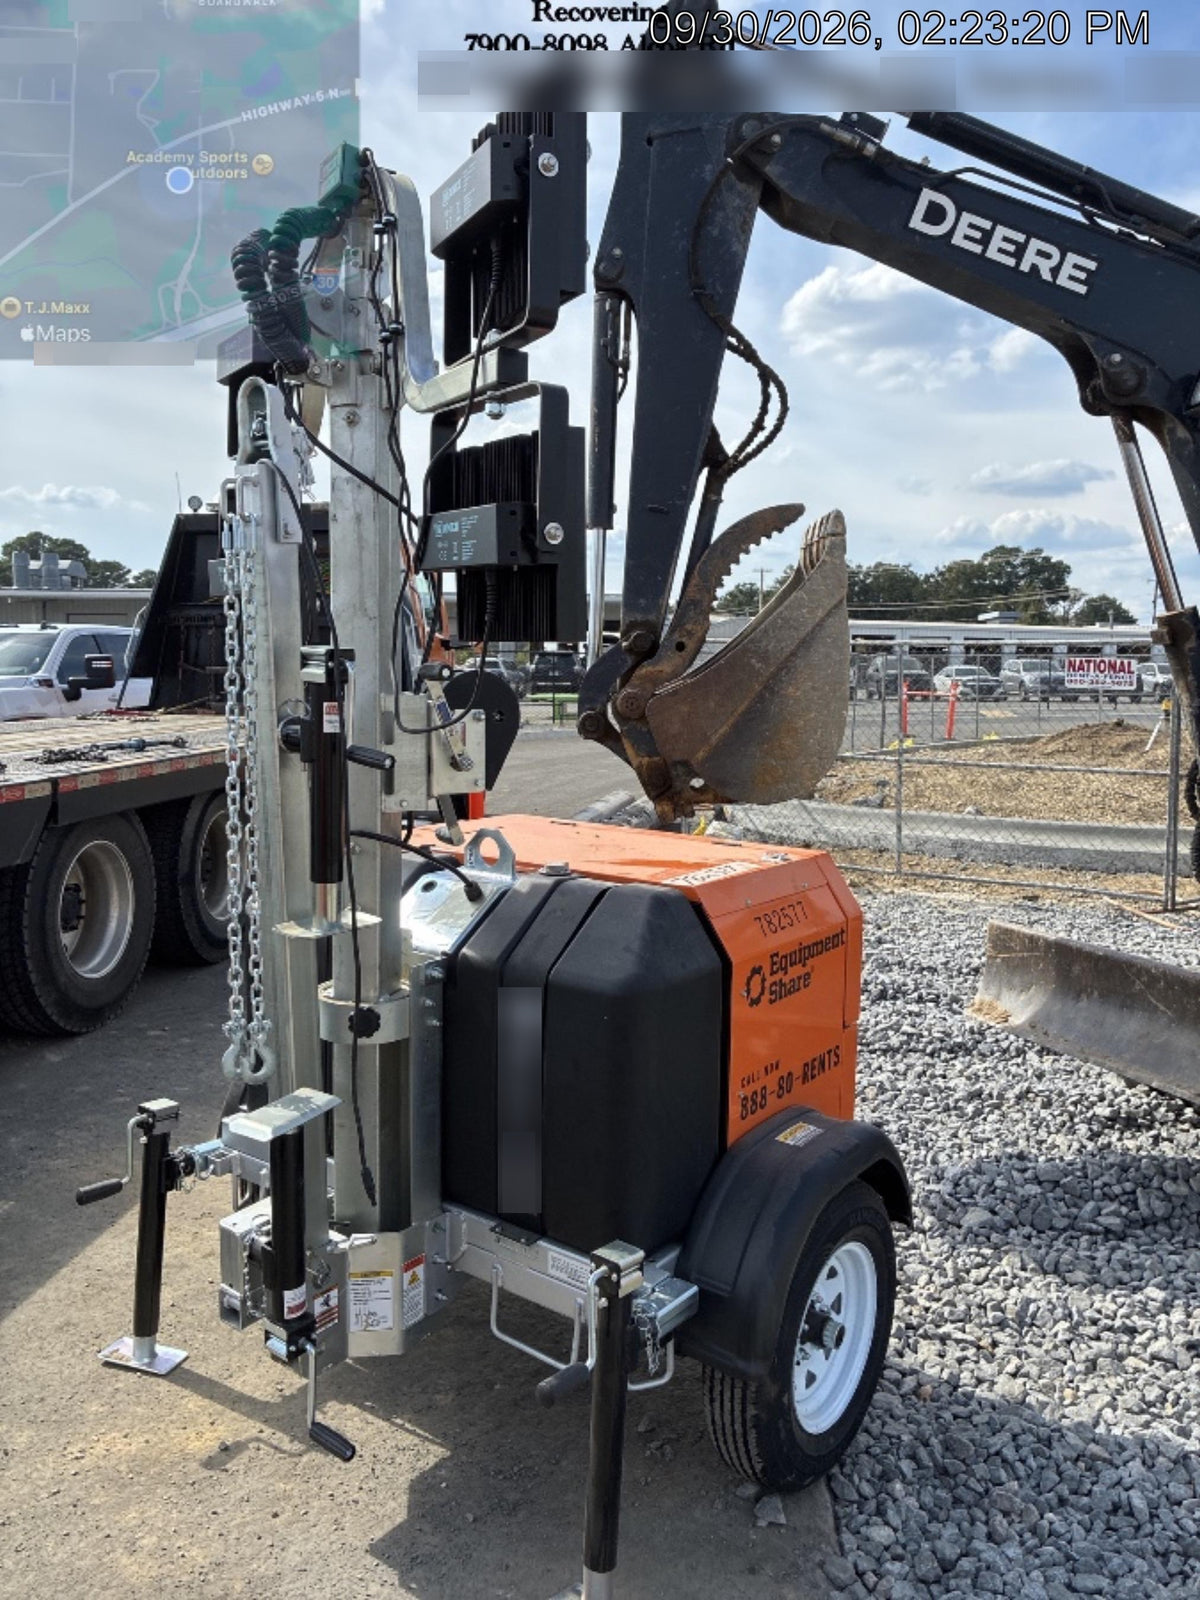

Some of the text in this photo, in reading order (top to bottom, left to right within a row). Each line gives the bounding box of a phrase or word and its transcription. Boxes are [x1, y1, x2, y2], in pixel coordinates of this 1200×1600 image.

[908, 187, 1098, 295] DEERE
[1067, 658, 1135, 675] NATIONAL
[753, 901, 808, 937] 782577
[769, 927, 846, 976] Equipment
[768, 971, 811, 1005] Share
[740, 1045, 840, 1121] 888-80-RENTS
